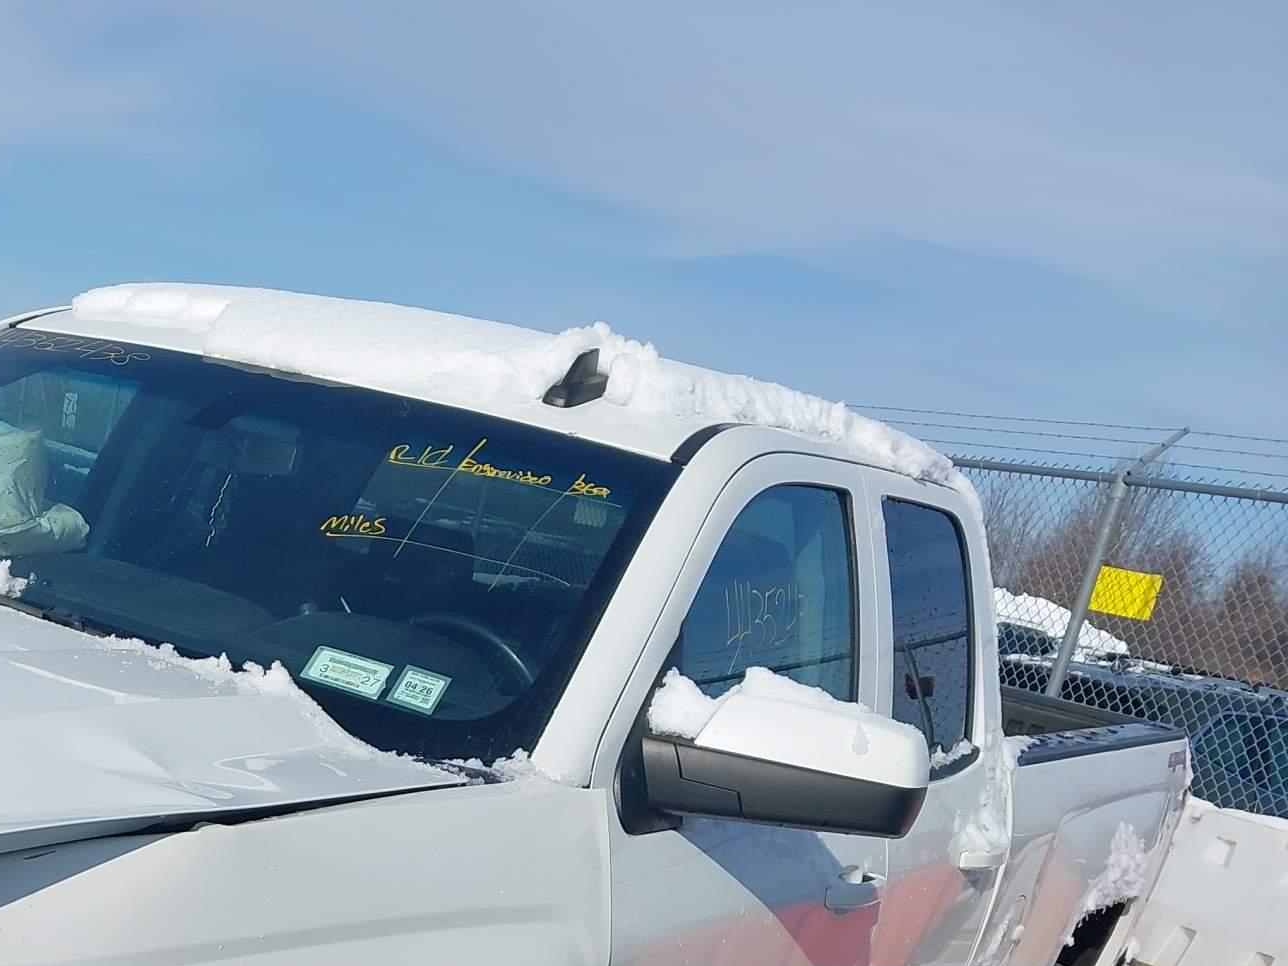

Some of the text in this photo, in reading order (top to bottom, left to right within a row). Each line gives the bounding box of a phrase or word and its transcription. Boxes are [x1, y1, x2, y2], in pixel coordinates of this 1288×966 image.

[319, 663, 330, 673] 3
[360, 675, 381, 687] 27
[404, 680, 434, 696] 04 26
